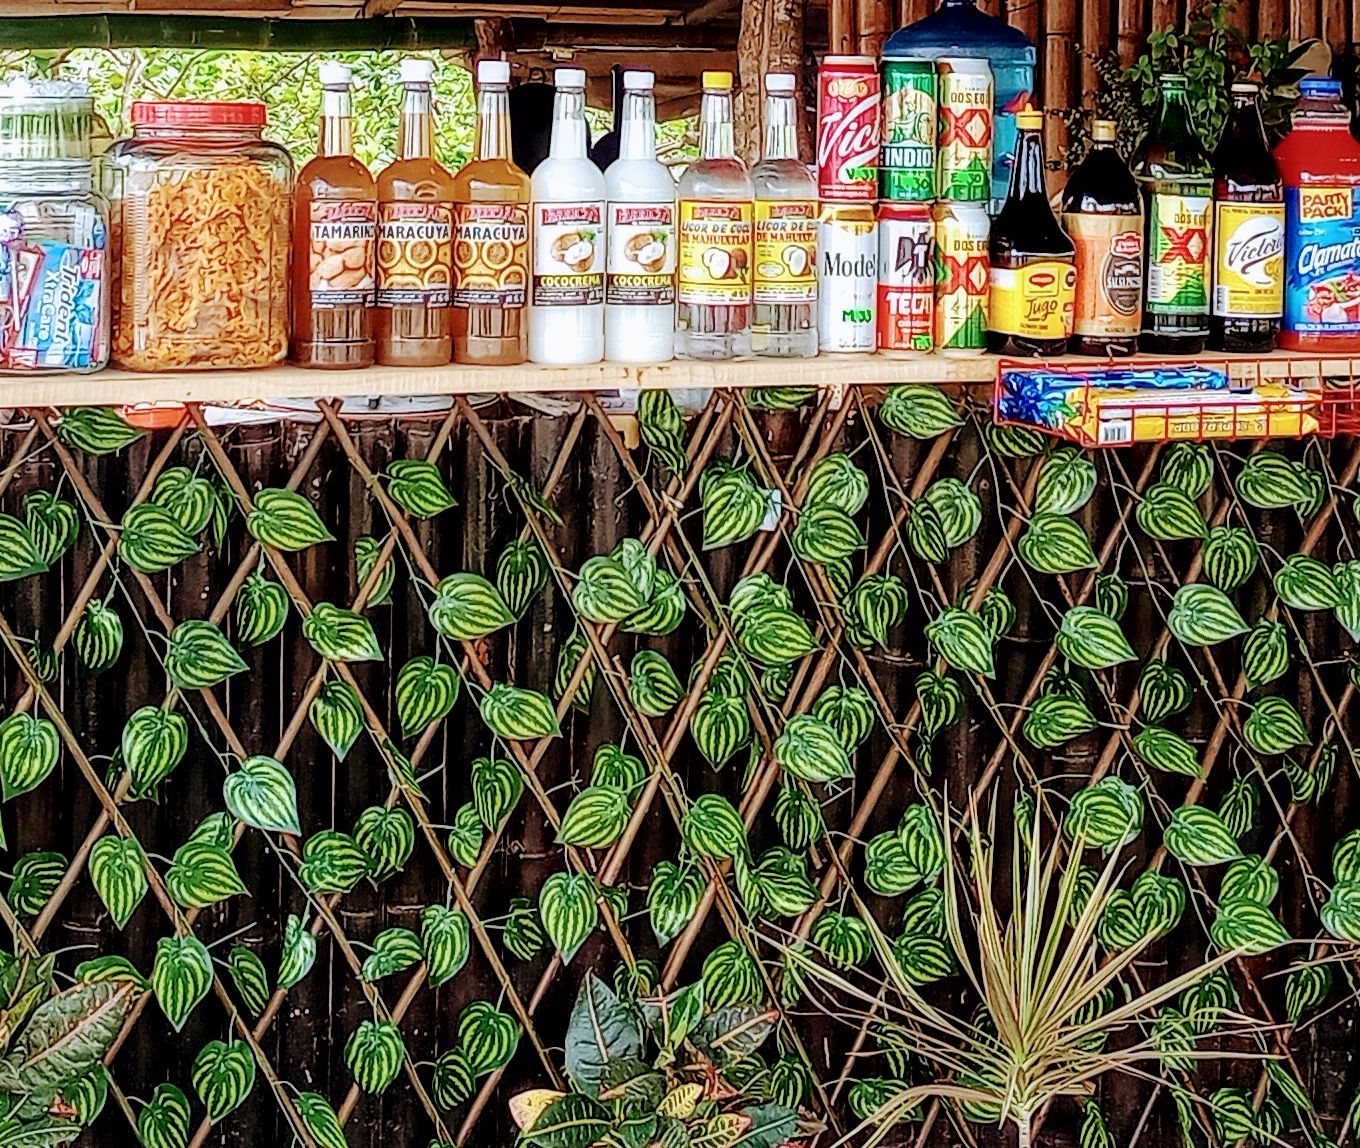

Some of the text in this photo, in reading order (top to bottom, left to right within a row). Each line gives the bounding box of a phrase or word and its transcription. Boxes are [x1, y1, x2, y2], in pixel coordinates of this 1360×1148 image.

[885, 147, 933, 168] INDIO
[1302, 192, 1349, 206] PARTY
[1302, 205, 1349, 219] PACK!
[540, 275, 602, 288] COCOCREMA
[613, 275, 673, 288] COCOCREMA
[52, 264, 80, 343] Trident
[1024, 297, 1059, 322] Jugo
